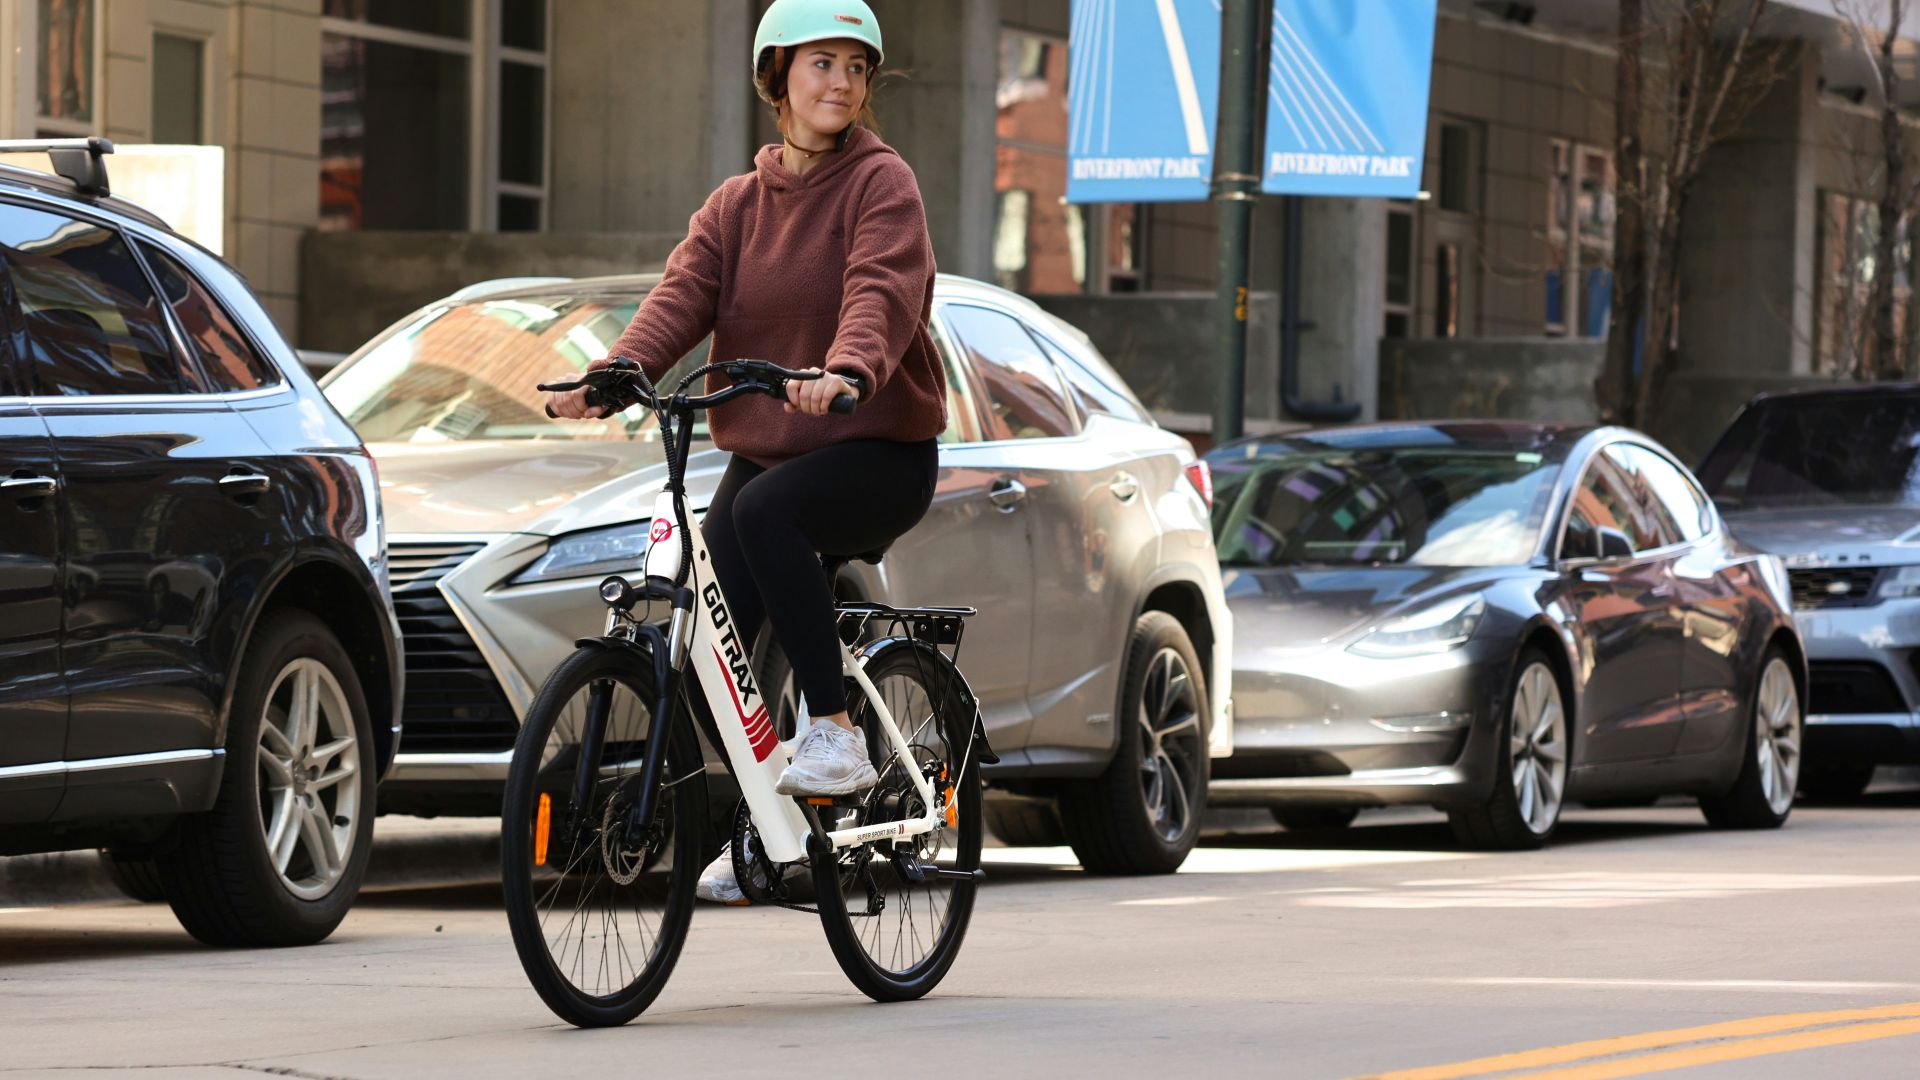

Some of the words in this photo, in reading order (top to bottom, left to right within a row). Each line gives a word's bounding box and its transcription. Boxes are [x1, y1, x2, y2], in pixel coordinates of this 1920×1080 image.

[1073, 157, 1162, 179] RIVERFRONT
[1163, 157, 1201, 179] PARK
[1272, 152, 1369, 176] RIVERFRONT
[1370, 156, 1410, 177] PARK
[857, 832, 871, 840] SUPER
[872, 830, 886, 838] SPORT
[887, 828, 896, 836] BIKE
